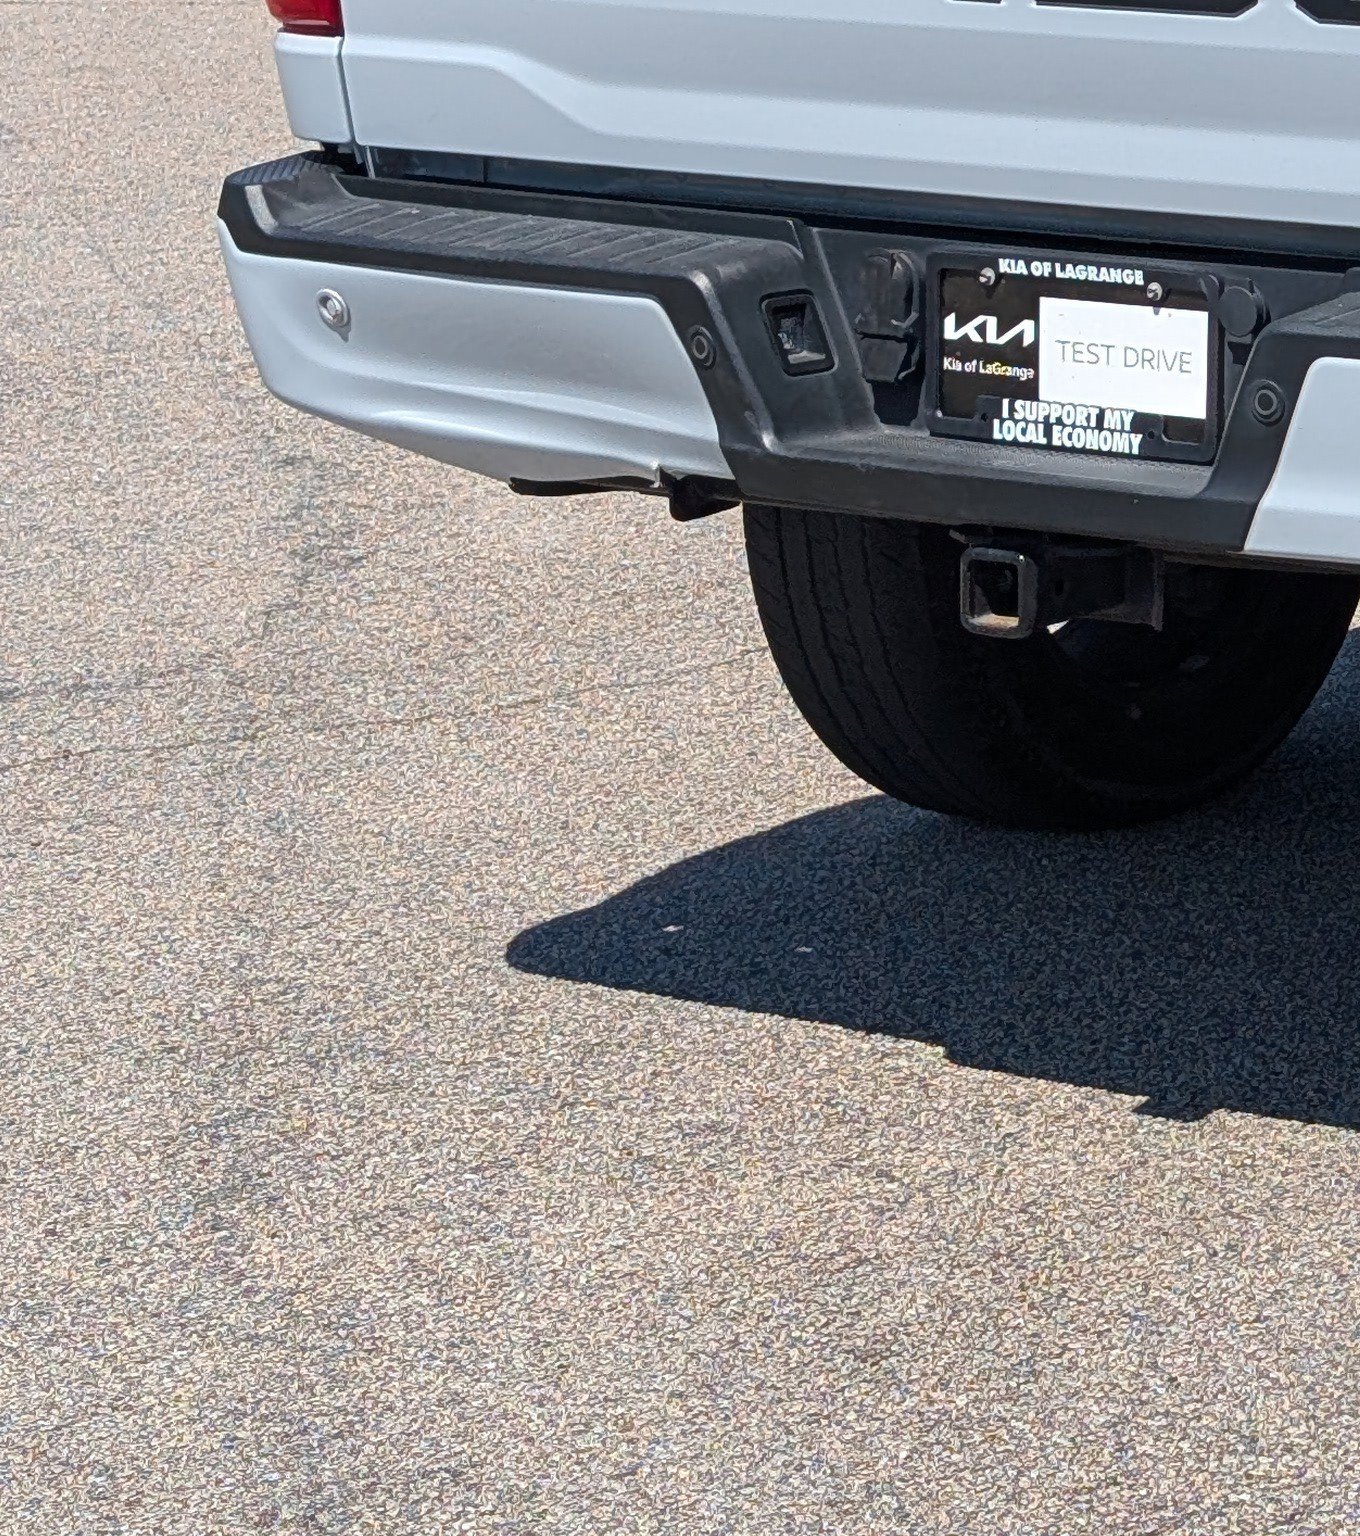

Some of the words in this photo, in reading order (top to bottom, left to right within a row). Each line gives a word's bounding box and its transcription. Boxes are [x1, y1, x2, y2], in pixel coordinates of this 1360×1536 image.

[998, 258, 1028, 275] KIA
[1030, 261, 1052, 277] OF
[1054, 263, 1145, 285] LAGRANGE
[943, 357, 962, 371] Kia
[964, 359, 977, 372] of
[979, 361, 1035, 380] LaGrange
[1054, 339, 1116, 366] TEST
[1123, 346, 1193, 374] DRIVE
[1002, 398, 1010, 419] I
[1013, 399, 1100, 428] SUPPORT
[1103, 408, 1136, 431] MY
[993, 418, 1048, 445] LOCAL
[1051, 424, 1144, 455] ECONOMY
